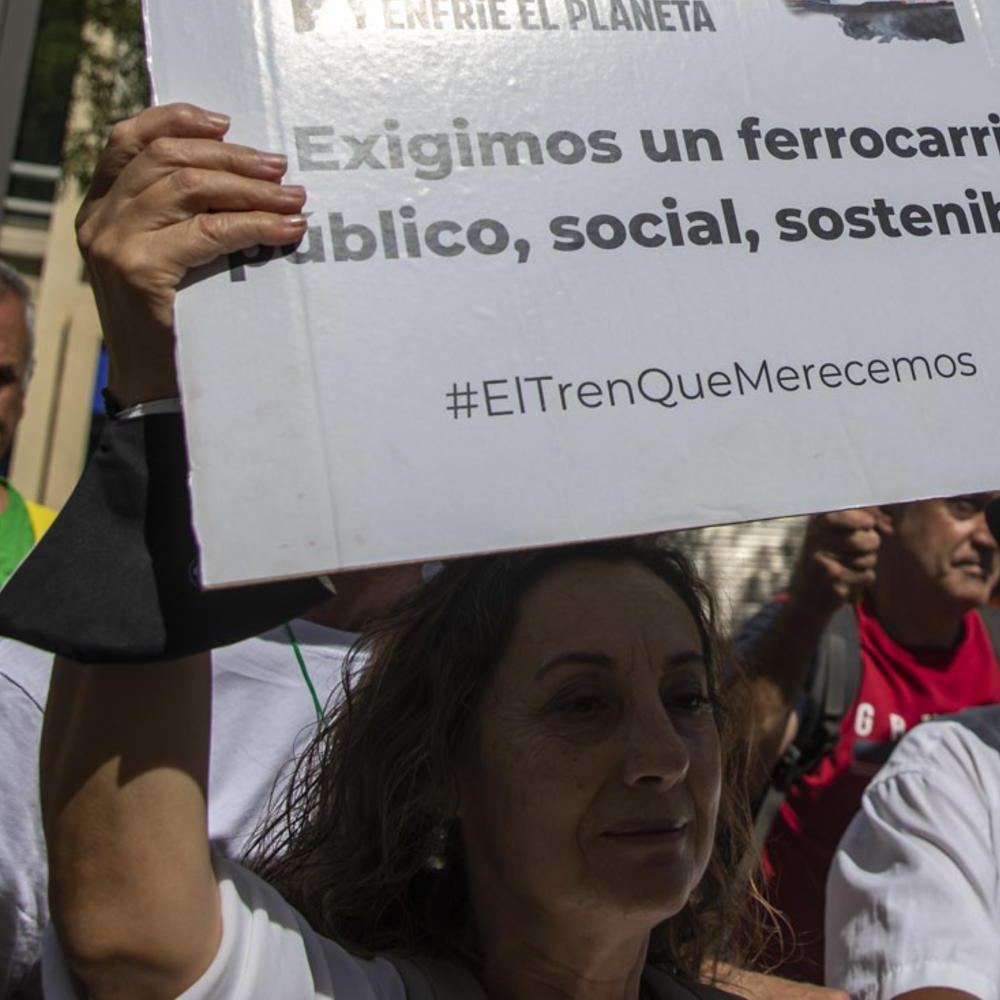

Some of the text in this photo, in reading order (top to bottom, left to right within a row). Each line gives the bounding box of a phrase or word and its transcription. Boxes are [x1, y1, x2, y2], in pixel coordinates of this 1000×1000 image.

[292, 117, 623, 181] Exigimos
[640, 127, 724, 163] un
[549, 196, 760, 253] social,
[446, 351, 978, 419] #ElTrenQueMerecemos
